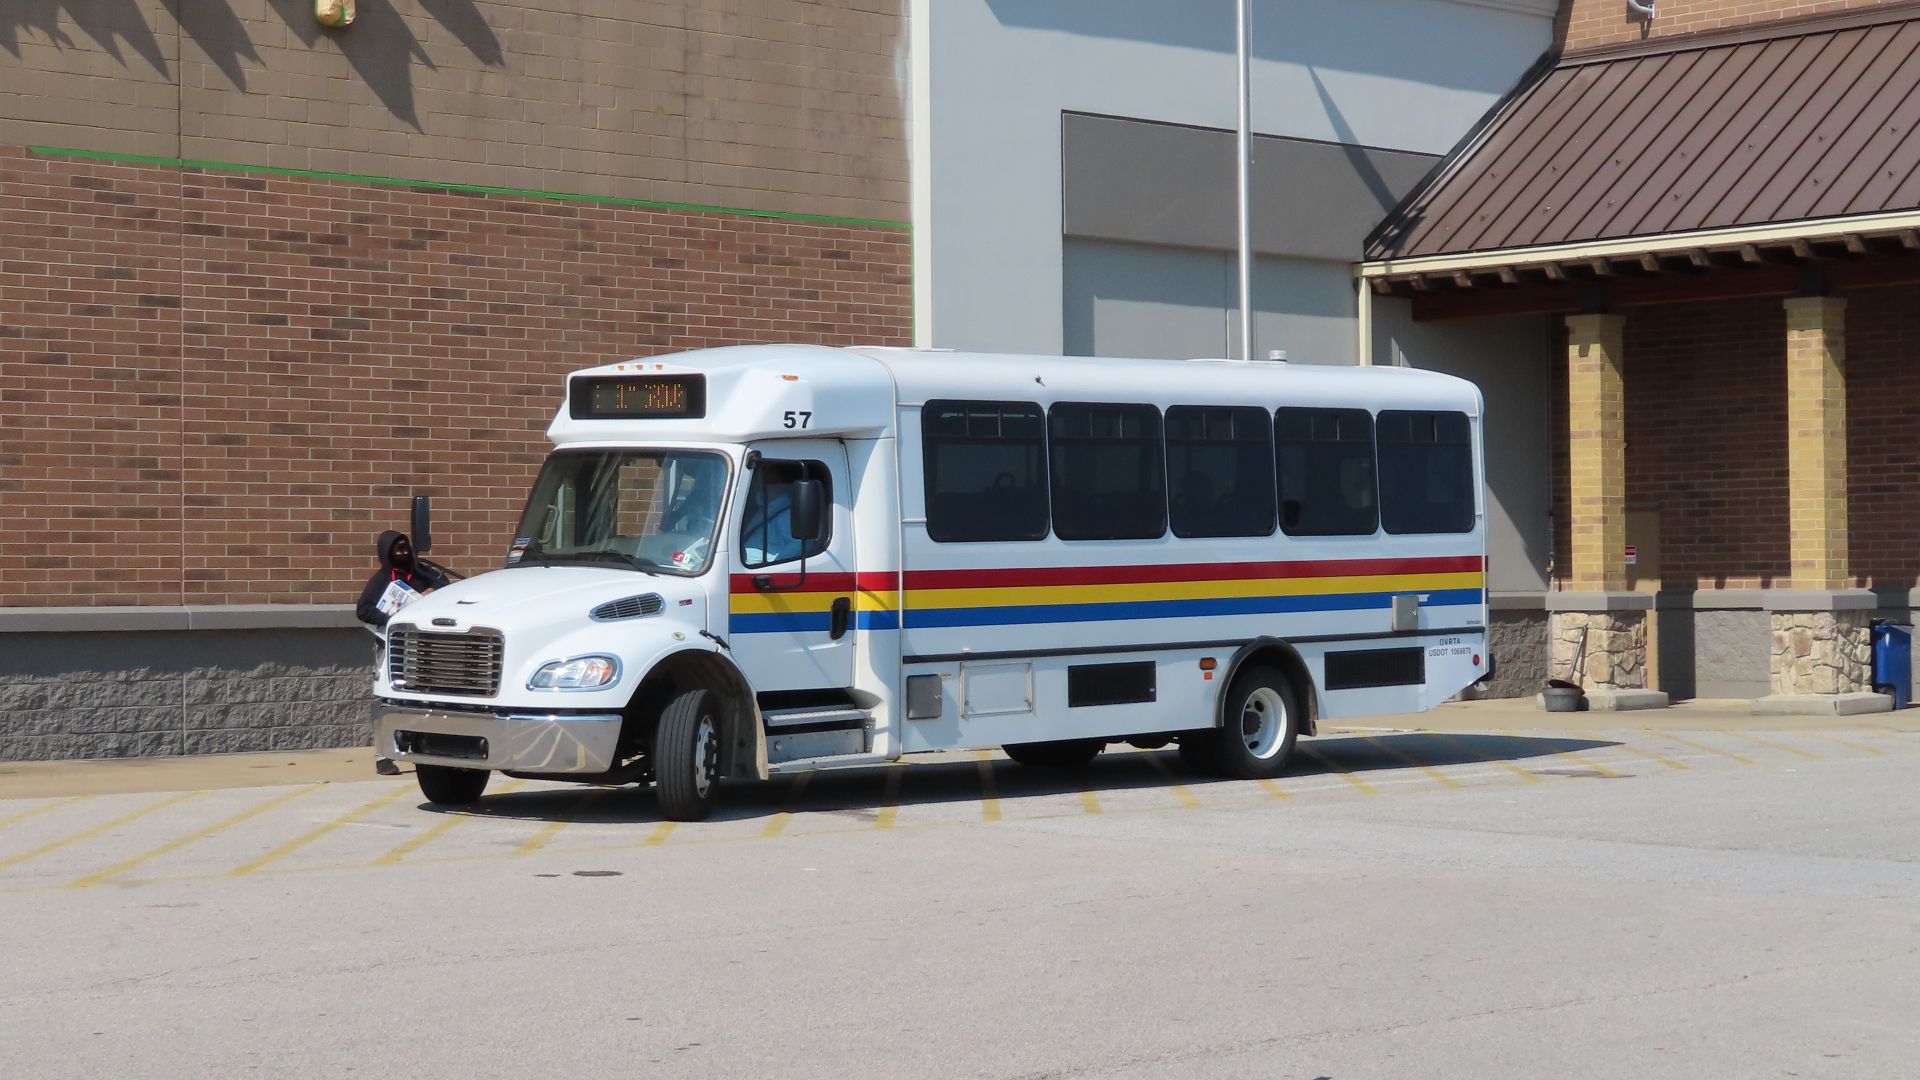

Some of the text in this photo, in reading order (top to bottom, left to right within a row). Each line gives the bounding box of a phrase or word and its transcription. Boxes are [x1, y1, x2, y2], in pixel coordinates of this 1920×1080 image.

[783, 410, 812, 429] 57
[1440, 637, 1461, 646] OVRTA
[1428, 648, 1448, 657] USDOT
